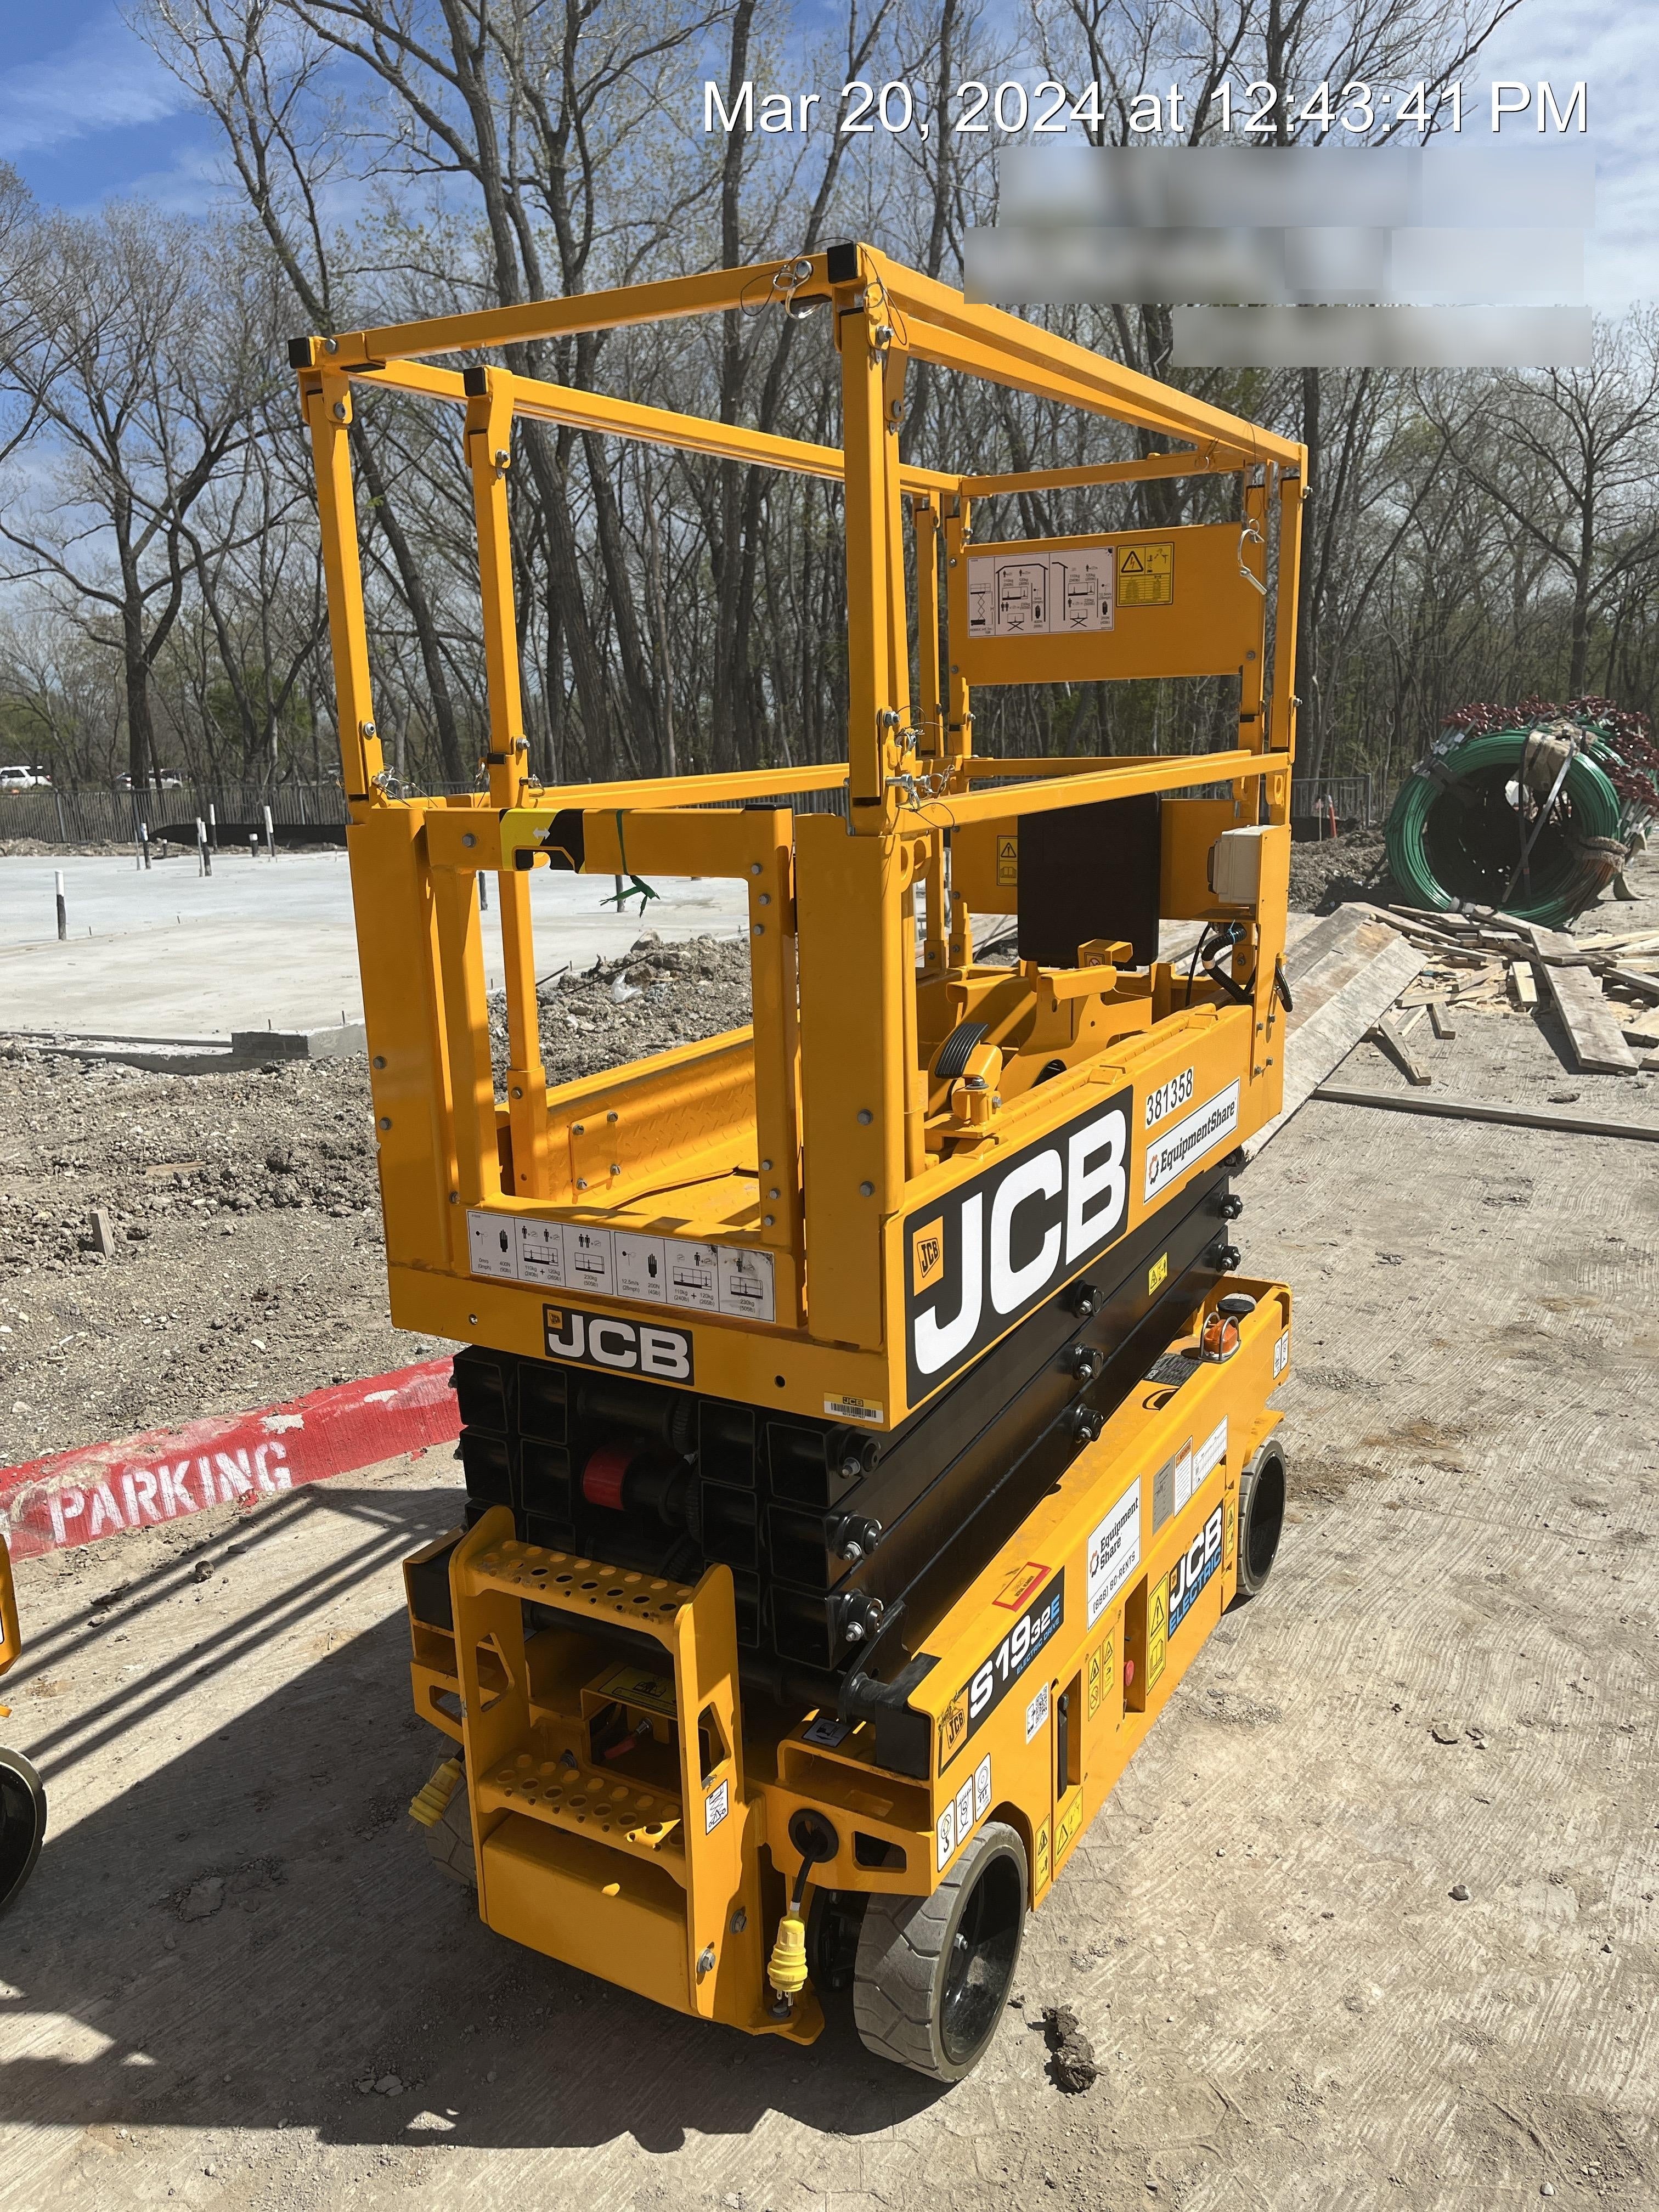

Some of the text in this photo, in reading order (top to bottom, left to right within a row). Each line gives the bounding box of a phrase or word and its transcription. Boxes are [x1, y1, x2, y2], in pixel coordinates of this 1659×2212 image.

[1146, 1068, 1193, 1126] 381358
[1160, 1101, 1235, 1173] EquipmentShare
[915, 1109, 1127, 1375] JCB
[921, 1240, 939, 1273] JCB
[549, 1314, 690, 1379] JCB
[843, 1397, 864, 1407] JCB
[48, 1440, 292, 1544] PARKING
[1100, 1497, 1139, 1554] Equipment
[1100, 1537, 1121, 1571] Share
[1170, 1507, 1222, 1613] JCB
[1169, 1545, 1222, 1637] ELECTRIC
[1017, 1616, 1060, 1675] ELECTRIC DRIVE
[949, 1712, 964, 1745] JCB
